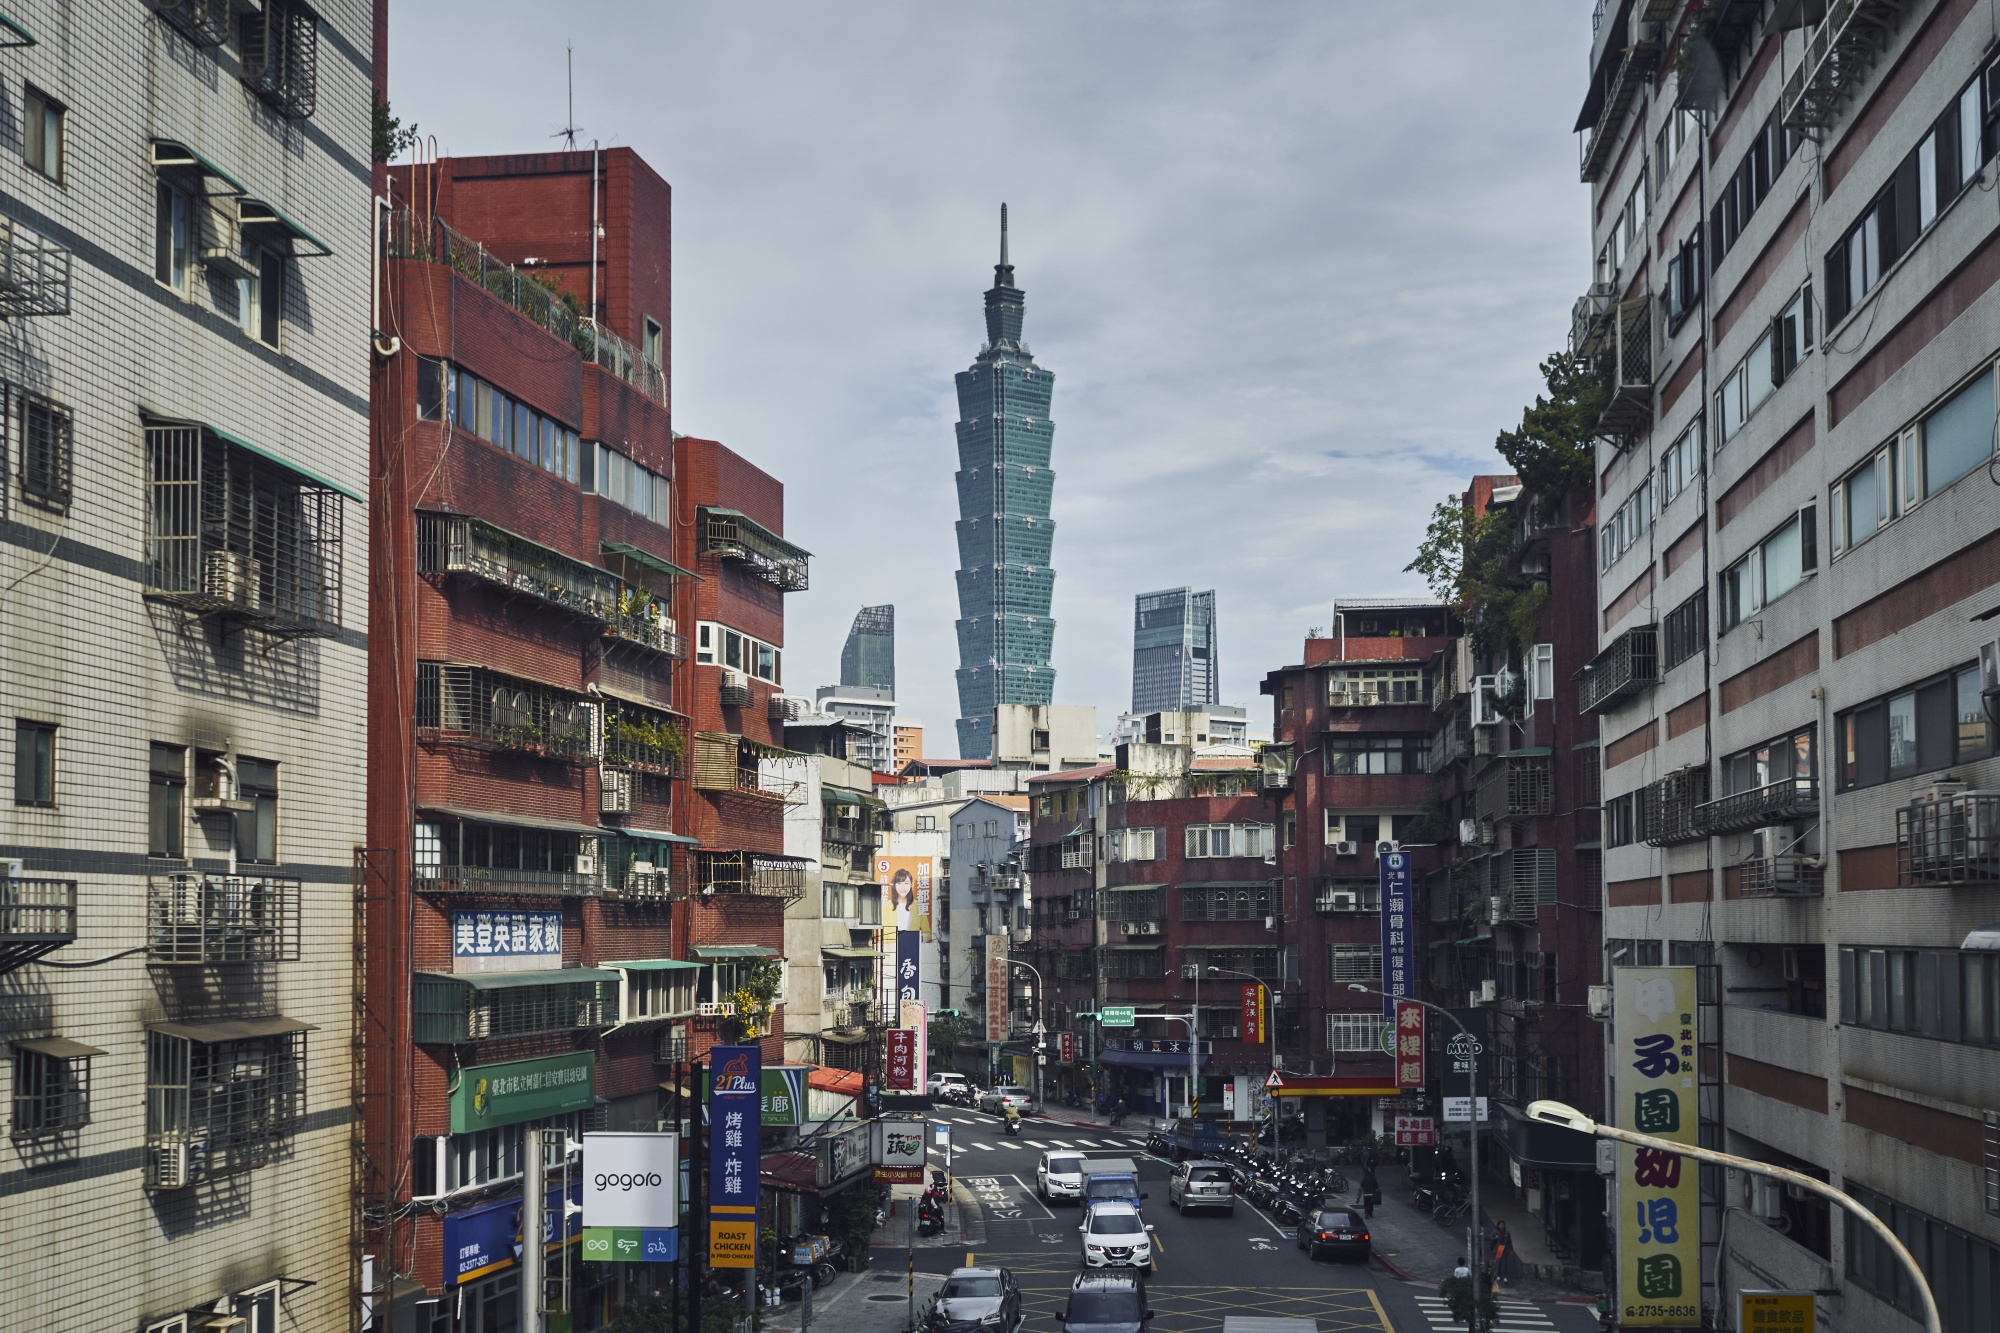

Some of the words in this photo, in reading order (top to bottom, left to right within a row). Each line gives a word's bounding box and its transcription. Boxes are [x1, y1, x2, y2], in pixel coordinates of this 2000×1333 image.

[880, 861, 887, 871] 5
[917, 863, 930, 916] 加速都更
[893, 1032, 908, 1077] 牛肉河粉
[715, 1075, 733, 1090] 21
[732, 1076, 756, 1090] Plus
[1399, 1119, 1431, 1129] 牛肉麵
[595, 1172, 662, 1191] gogoro
[718, 1232, 747, 1240] ROAST
[713, 1243, 751, 1251] CHICKEN
